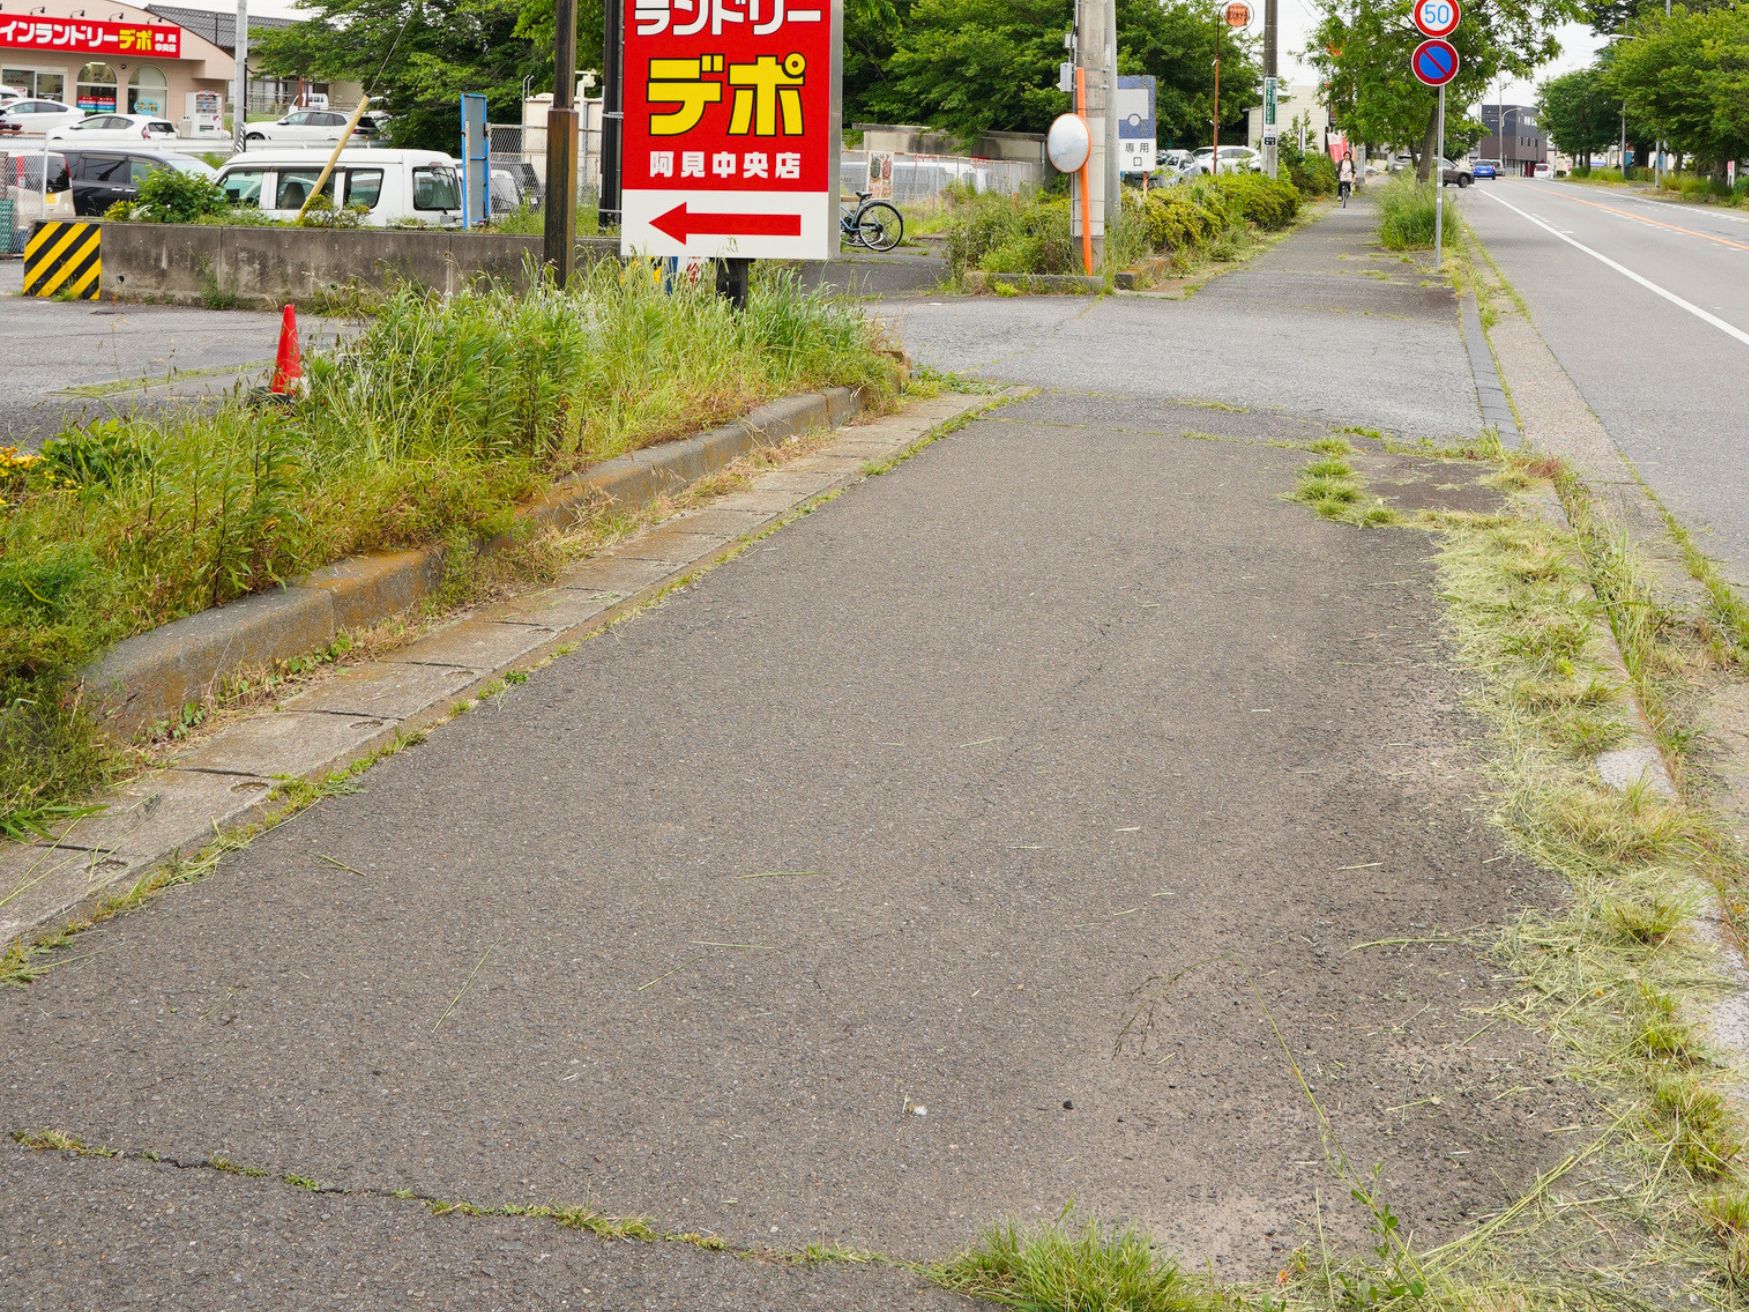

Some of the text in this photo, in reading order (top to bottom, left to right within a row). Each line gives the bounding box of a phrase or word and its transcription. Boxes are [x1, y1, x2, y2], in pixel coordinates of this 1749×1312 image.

[1425, 4, 1449, 24] 50
[647, 52, 806, 136] デポ
[649, 151, 801, 179] 阿見中央店
